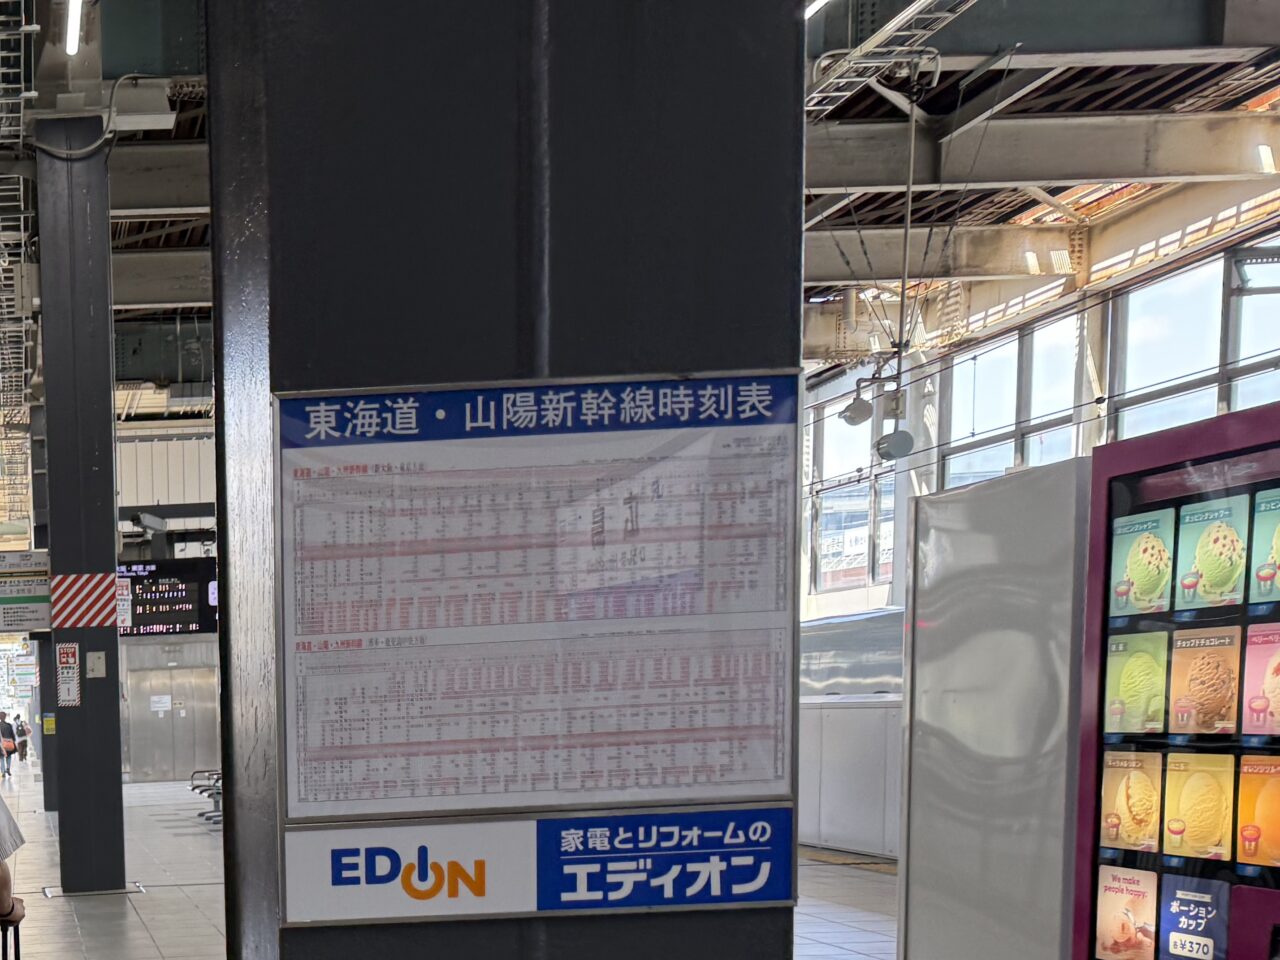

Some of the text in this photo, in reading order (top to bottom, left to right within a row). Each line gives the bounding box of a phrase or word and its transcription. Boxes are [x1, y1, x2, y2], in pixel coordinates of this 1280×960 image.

[304, 383, 774, 440] 東海道・山陽新幹線時刻表
[560, 821, 772, 853] 家電とリフォームの
[331, 845, 486, 901] EDION
[560, 856, 772, 903] エディオン
[1111, 873, 1141, 886] We make
[1103, 885, 1125, 896] people
[1170, 899, 1217, 919] ポーション
[1178, 916, 1208, 931] カップ
